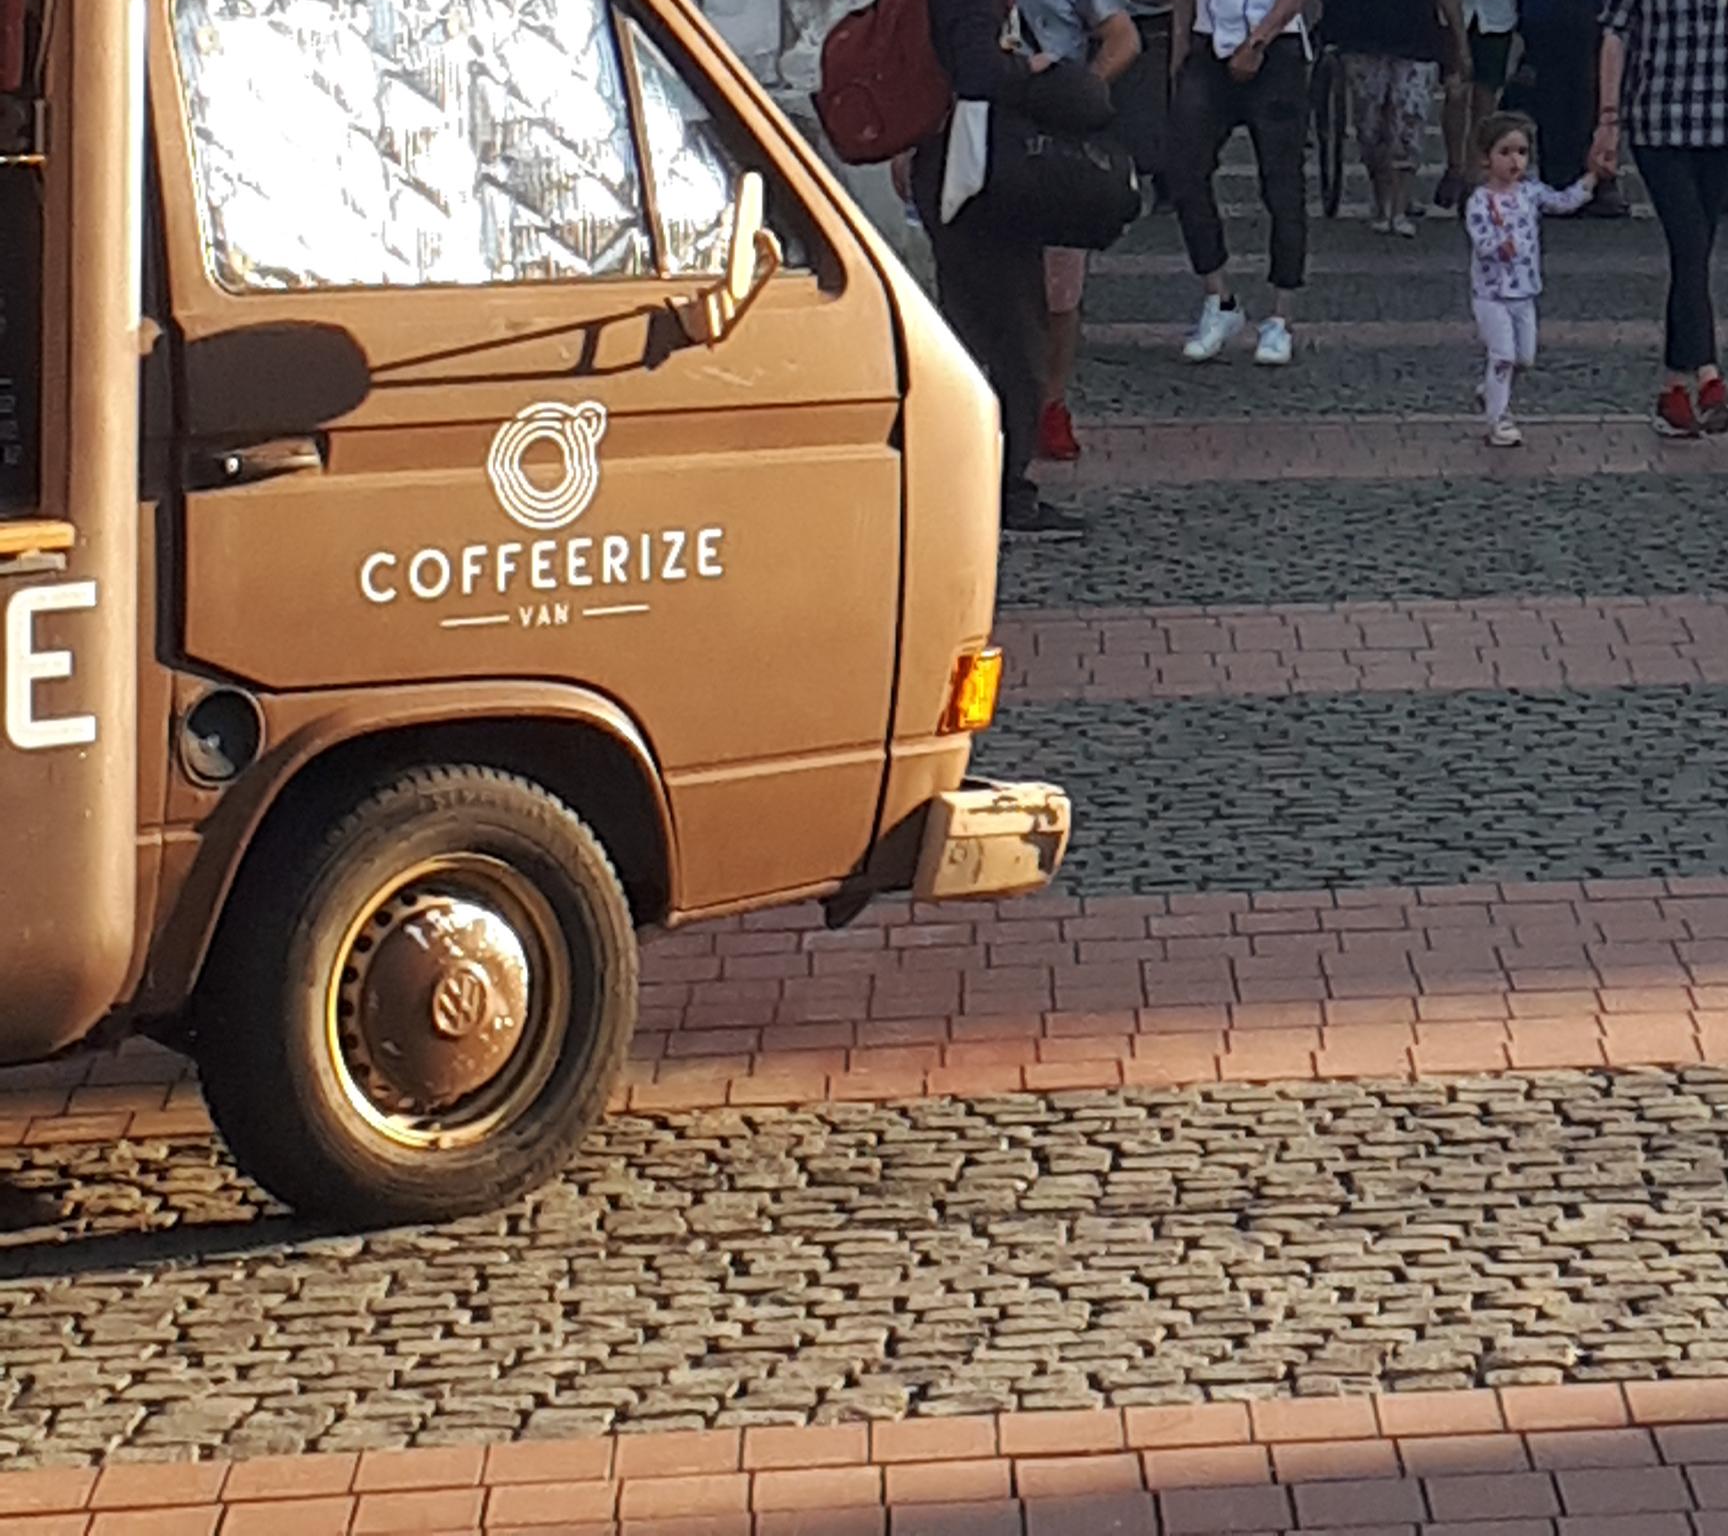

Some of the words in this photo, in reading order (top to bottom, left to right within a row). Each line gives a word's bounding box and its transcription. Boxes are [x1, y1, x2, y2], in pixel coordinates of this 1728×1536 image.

[360, 527, 724, 603] COFFEERIZE
[518, 602, 569, 629] VAN
[5, 581, 98, 749] E
